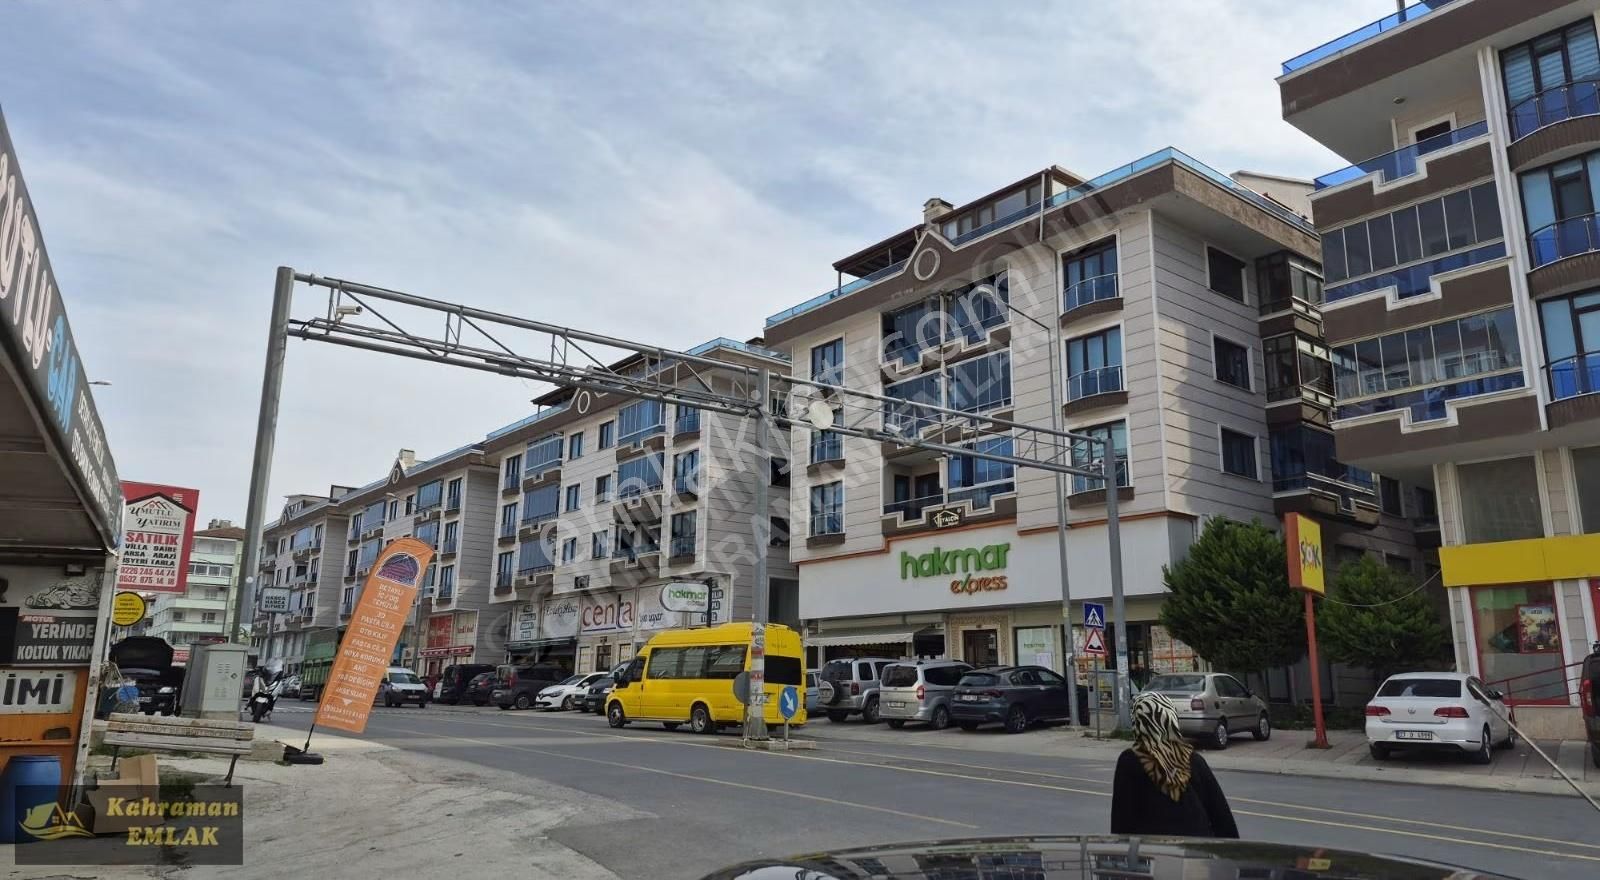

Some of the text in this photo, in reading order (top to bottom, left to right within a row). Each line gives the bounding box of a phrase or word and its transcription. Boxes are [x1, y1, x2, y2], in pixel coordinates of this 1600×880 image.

[136, 518, 181, 528] YATIRIM
[126, 532, 179, 545] SATILIK
[900, 543, 1011, 580] hakmar
[950, 574, 1008, 595] express
[668, 588, 707, 600] hakmar
[582, 594, 634, 628] centa
[23, 615, 55, 623] MOTUL
[32, 621, 95, 639] YERİNDE
[17, 645, 59, 660] KOLTUK
